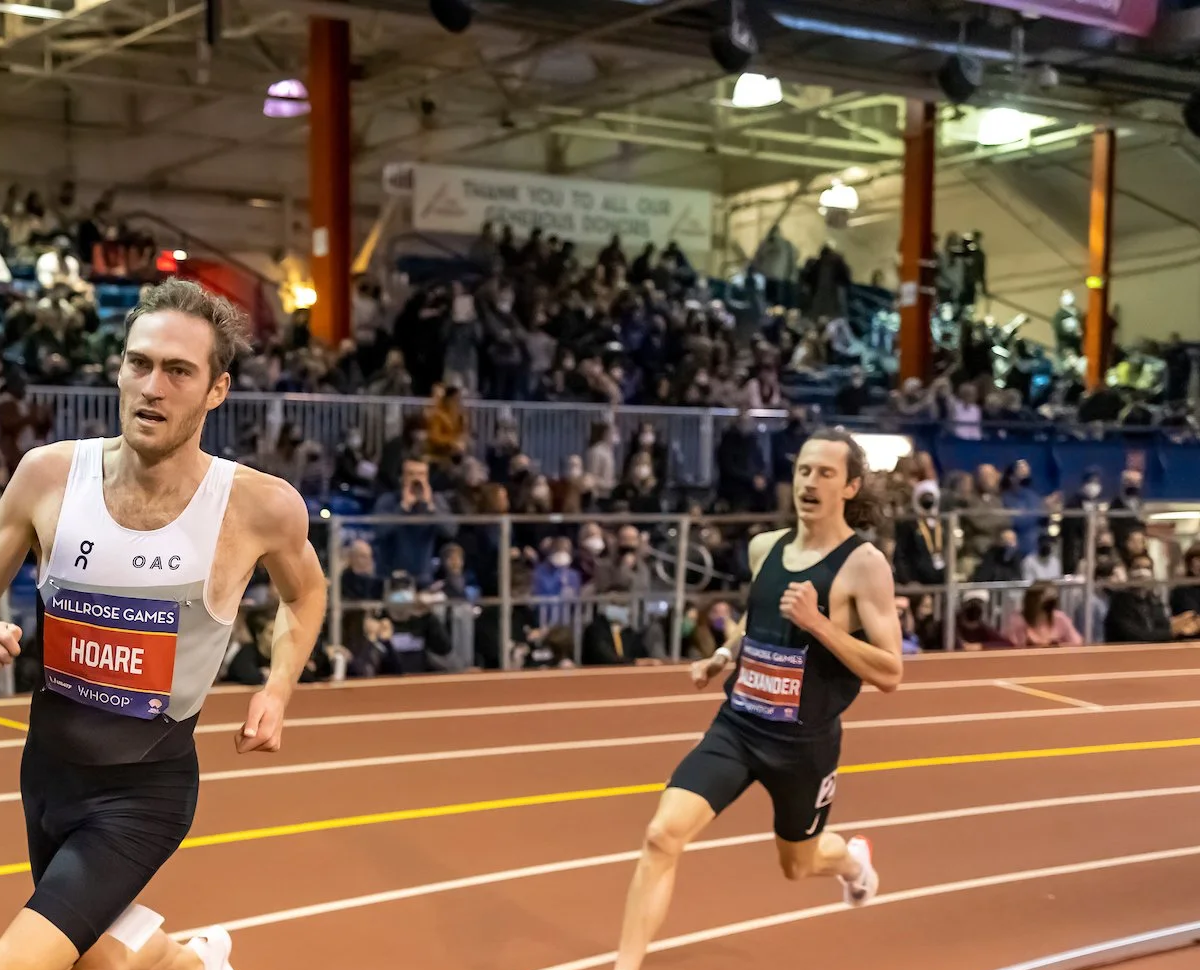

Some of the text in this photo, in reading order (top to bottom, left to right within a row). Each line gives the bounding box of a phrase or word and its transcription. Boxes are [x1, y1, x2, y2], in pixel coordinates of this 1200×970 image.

[463, 178, 671, 217] THANK YOU TO ALL OUR
[485, 205, 574, 231] GENEROUS
[582, 214, 651, 236] DONORS
[132, 555, 181, 570] OAC
[52, 596, 175, 625] MILLROSE GAMES
[70, 636, 145, 675] HOARE
[77, 684, 131, 708] WHOOP
